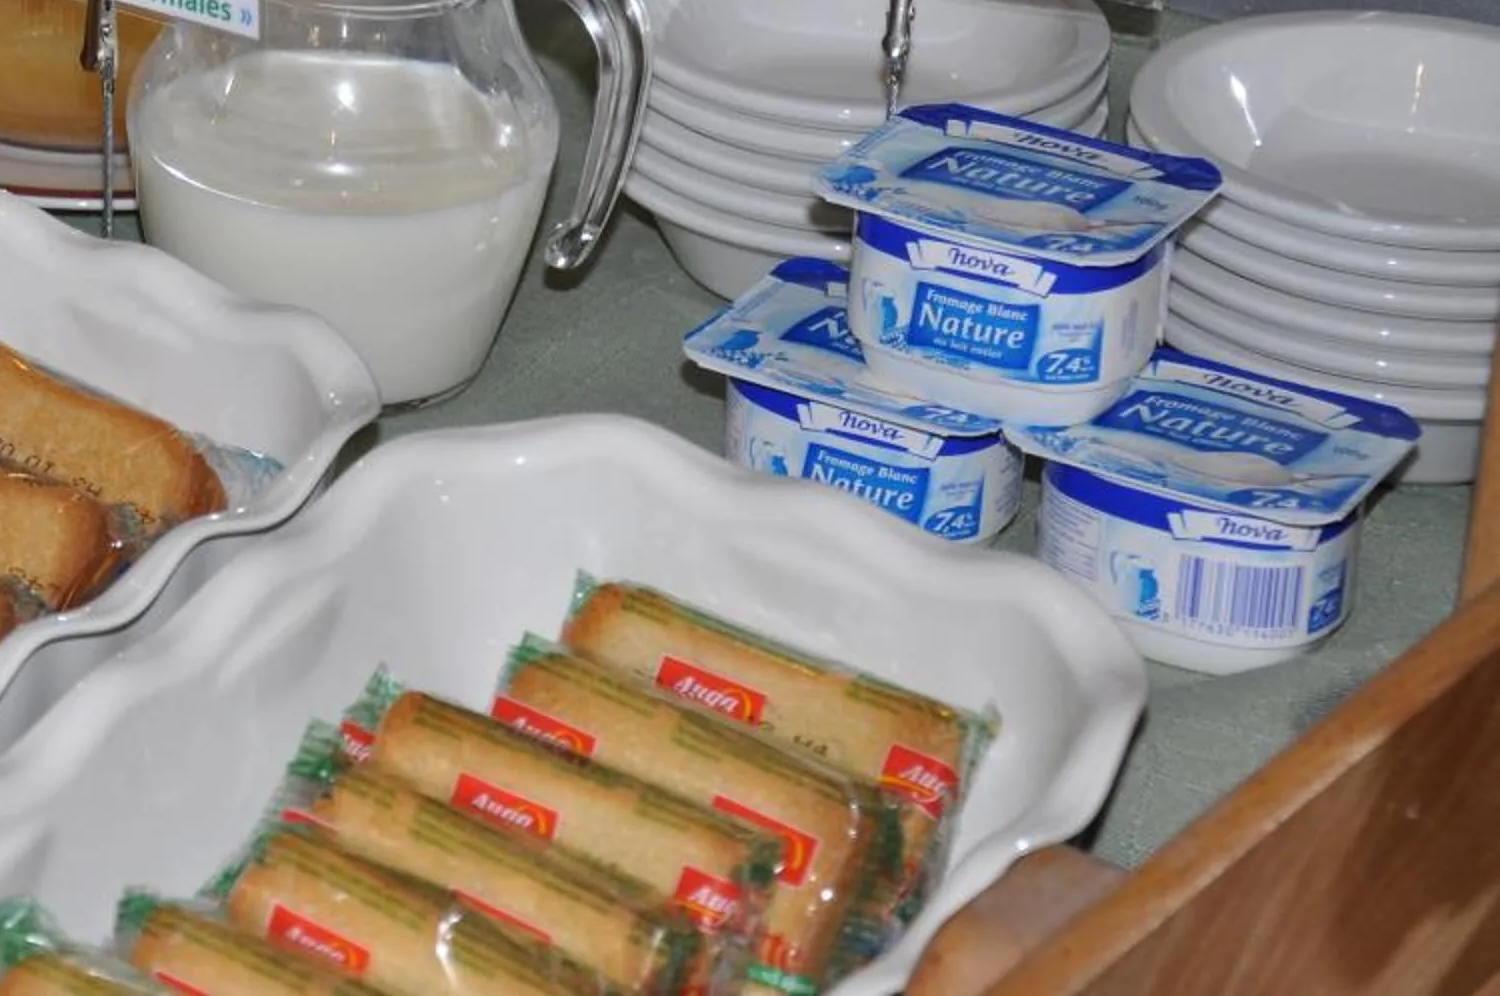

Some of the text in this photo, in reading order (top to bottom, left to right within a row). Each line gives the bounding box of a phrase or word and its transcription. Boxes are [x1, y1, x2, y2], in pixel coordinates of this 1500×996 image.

[926, 154, 1097, 204] Nature
[947, 247, 1015, 277] nova
[925, 287, 1029, 323] Fromage Blanc
[917, 304, 1026, 350] Nature
[1203, 371, 1298, 406] nova
[837, 411, 909, 442] nova
[1119, 401, 1296, 455] Nature
[816, 449, 918, 486] Fromage Blanc
[809, 464, 916, 511] Nature
[1217, 516, 1289, 543] nova
